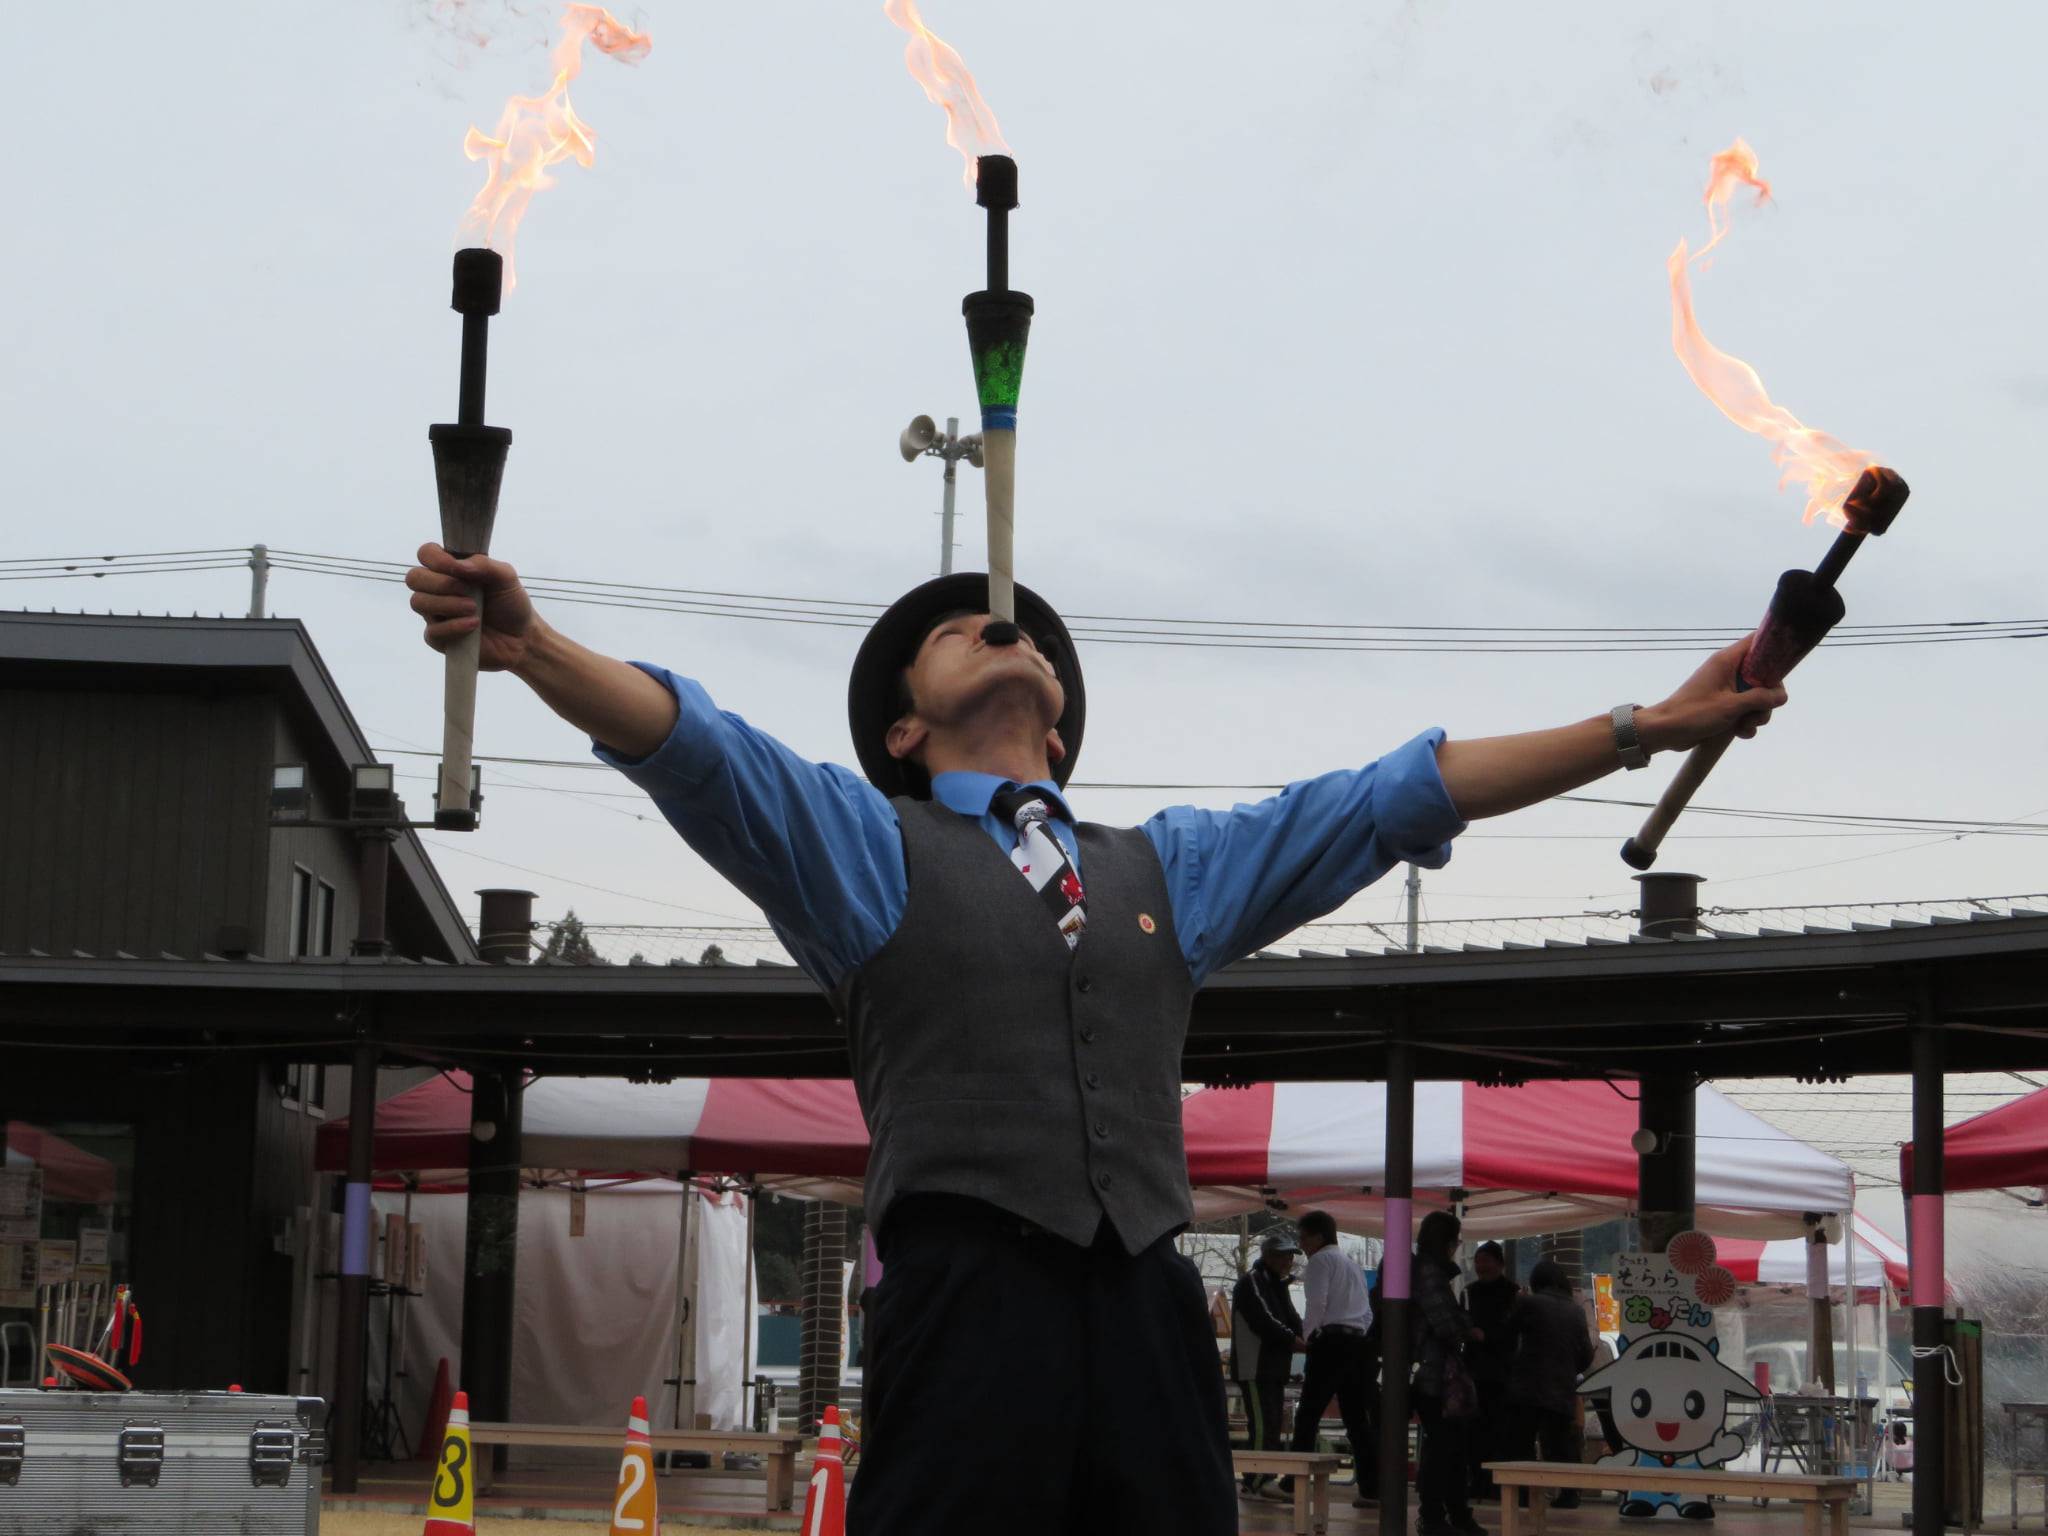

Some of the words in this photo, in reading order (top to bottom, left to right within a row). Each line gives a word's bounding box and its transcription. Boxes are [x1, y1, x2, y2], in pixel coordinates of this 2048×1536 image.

[1625, 1295, 1712, 1329] おみたん
[434, 1435, 467, 1508] 3
[614, 1454, 646, 1530] 2
[809, 1467, 828, 1536] 1
